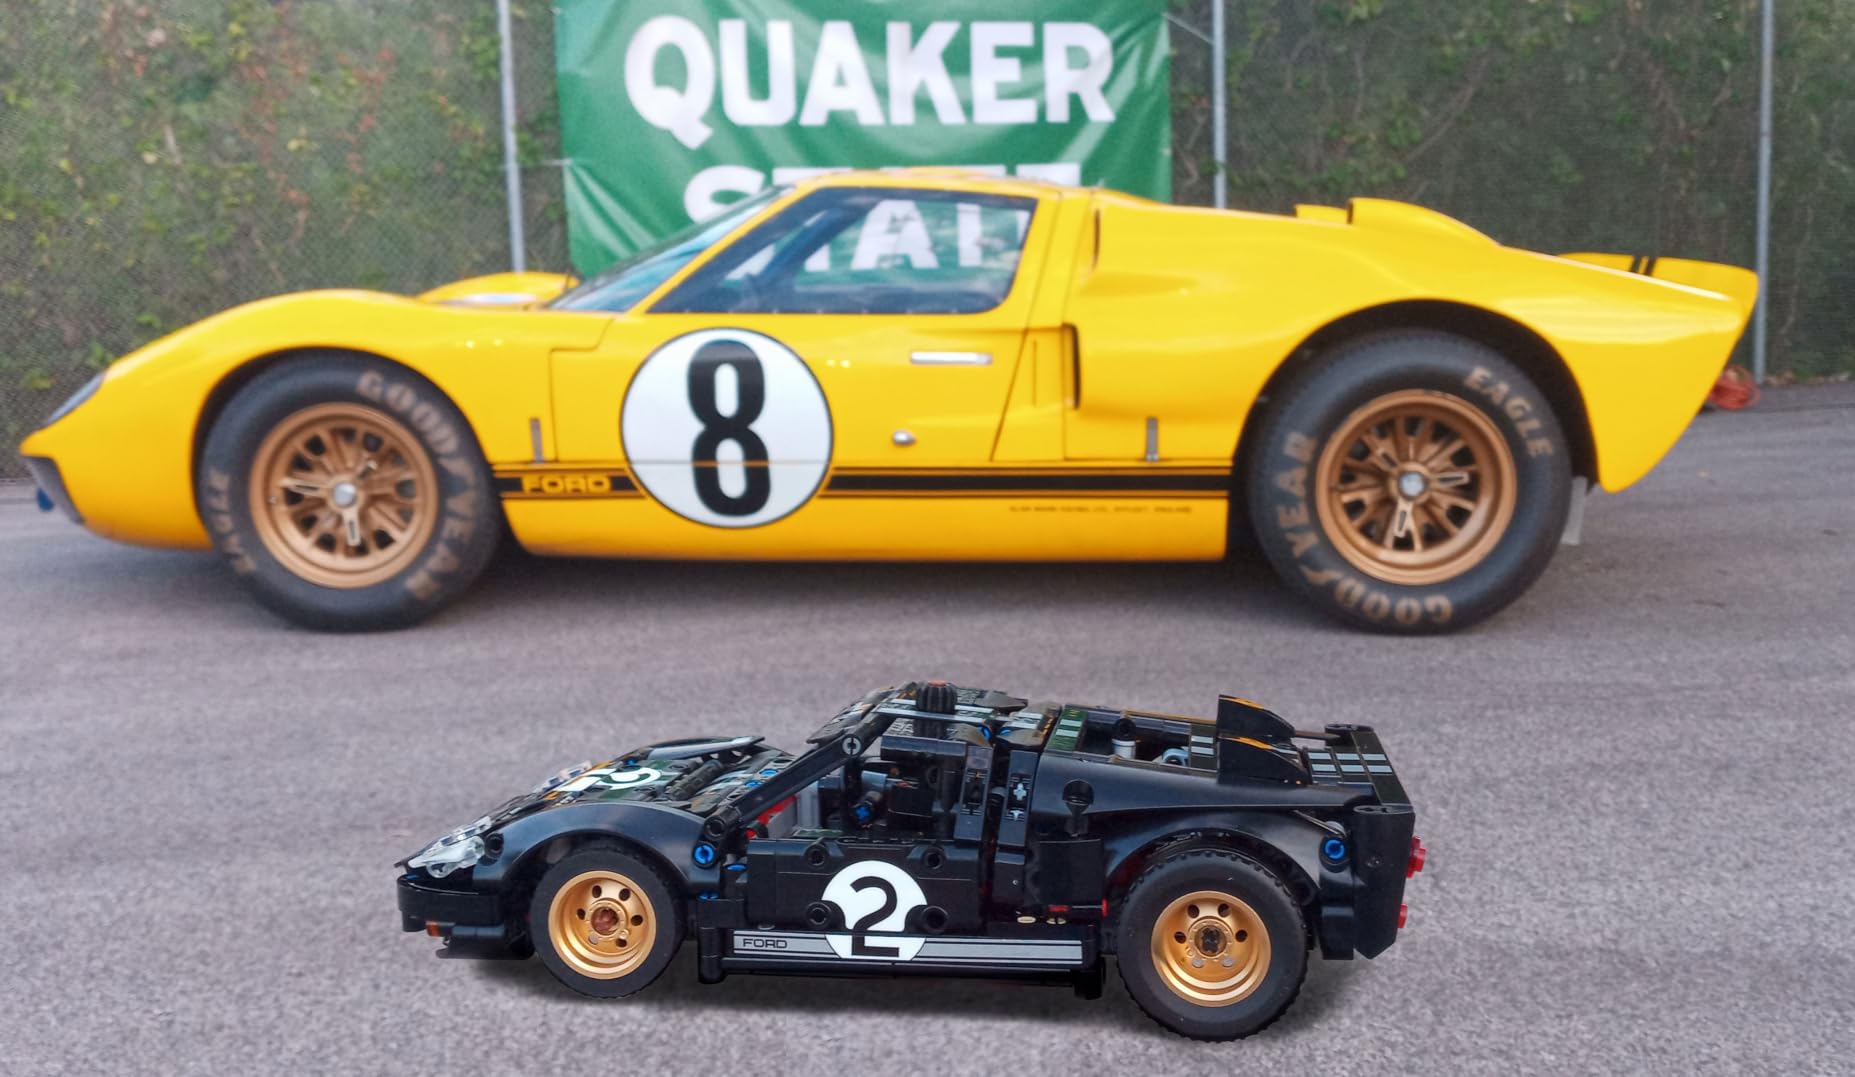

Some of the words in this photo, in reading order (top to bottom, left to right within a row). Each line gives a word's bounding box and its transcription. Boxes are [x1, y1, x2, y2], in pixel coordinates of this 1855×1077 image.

[623, 15, 1116, 150] QUAKER
[687, 338, 771, 517] 8
[1463, 366, 1553, 458] EAGLE
[521, 474, 612, 494] FORD
[742, 938, 788, 949] FORD
[849, 875, 900, 957] 2
